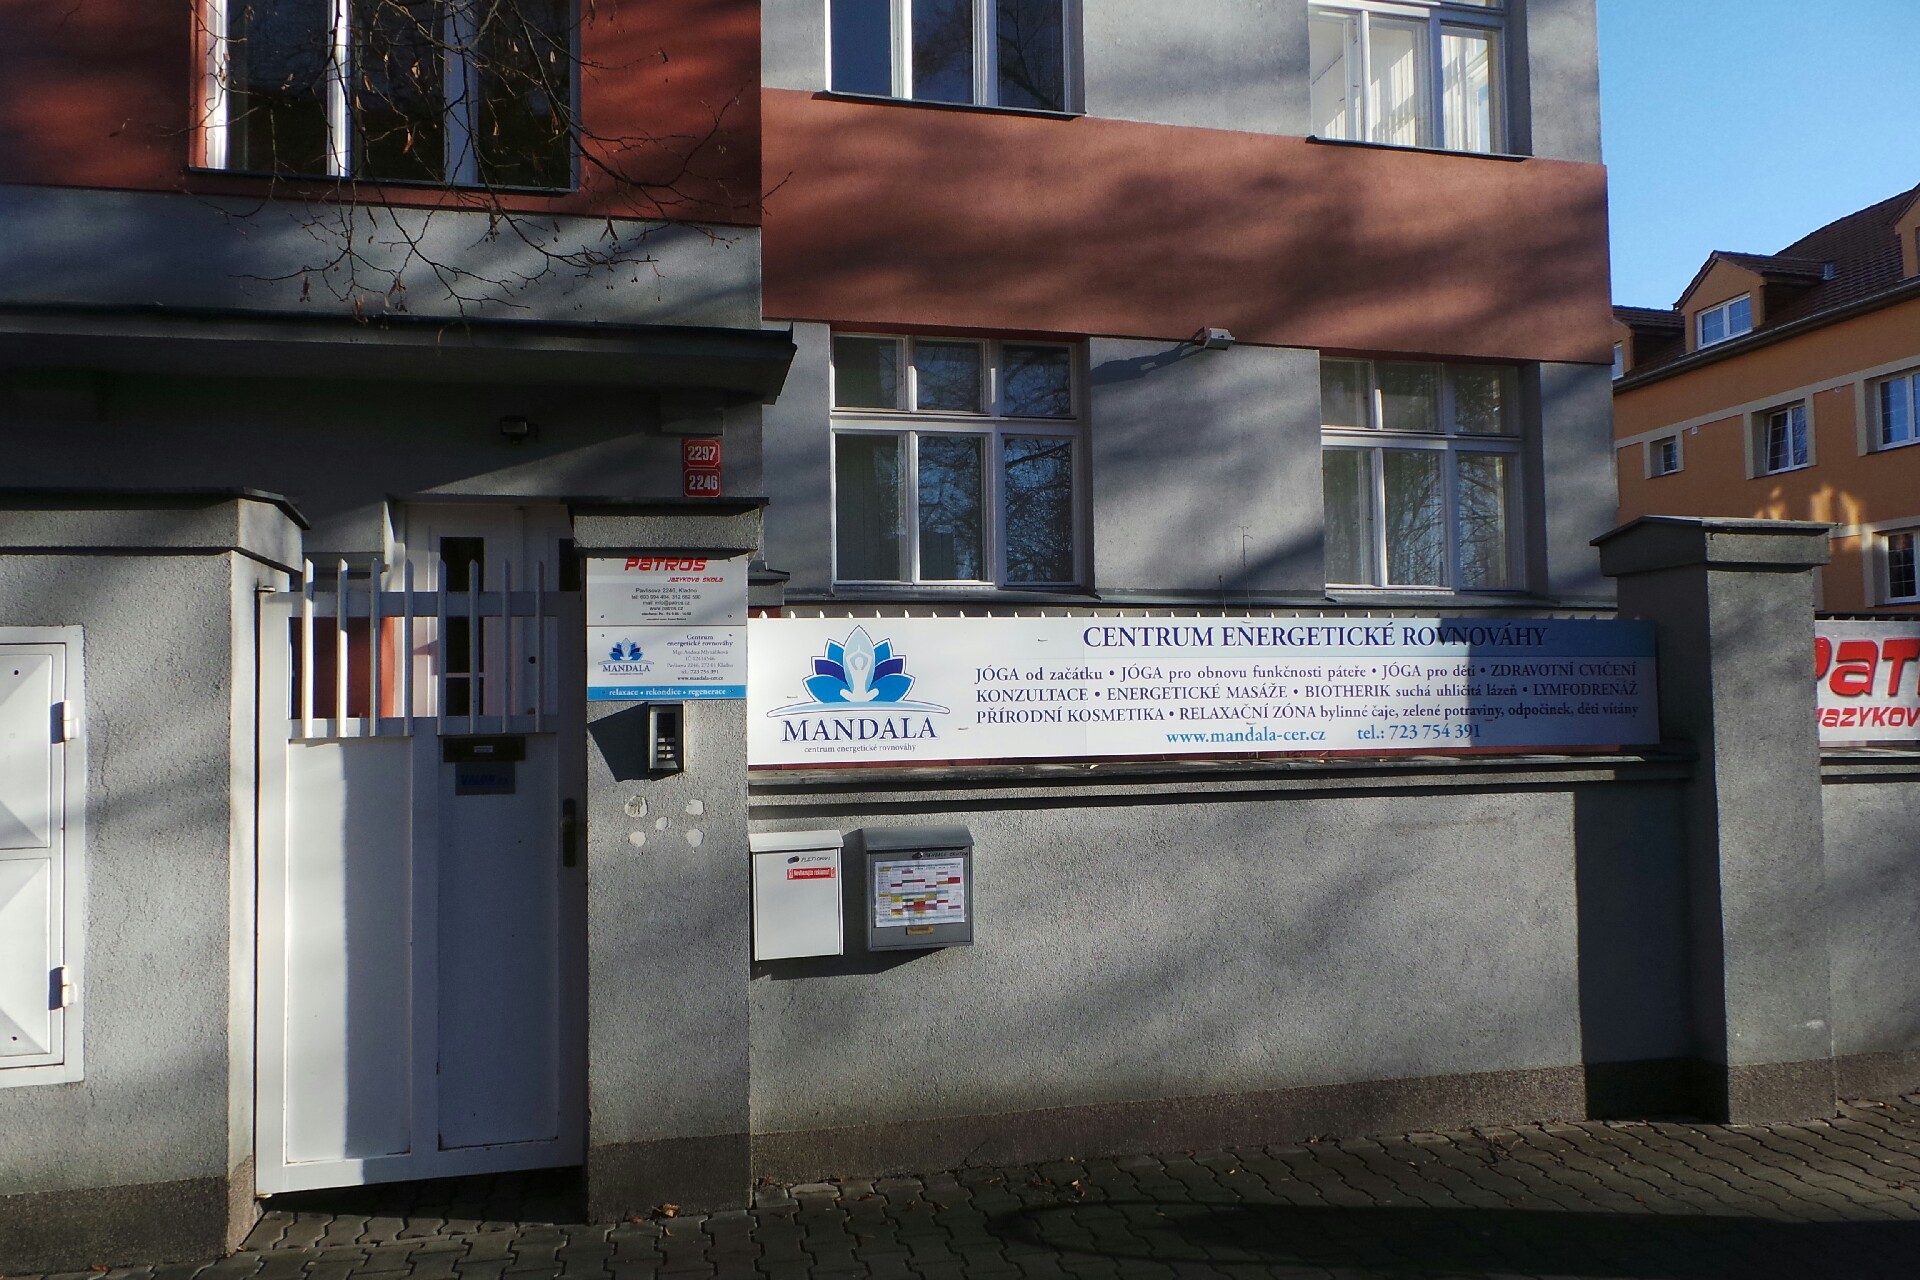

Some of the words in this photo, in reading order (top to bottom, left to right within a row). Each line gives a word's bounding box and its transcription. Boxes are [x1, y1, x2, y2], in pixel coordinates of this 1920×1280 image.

[688, 446, 716, 460] 2297
[689, 475, 717, 490] 2246
[1084, 626, 1214, 647] CENTRUM
[1221, 622, 1393, 647] ENERGETICKÉ
[1402, 623, 1548, 646] ROVNOVÁHY
[975, 664, 1018, 684] JÓGA
[1025, 667, 1043, 681] od
[1049, 665, 1103, 680] začátku
[1120, 663, 1162, 682] JÓGA
[1169, 669, 1191, 682] pro
[1198, 666, 1247, 679] obnovu
[1253, 664, 1321, 678] funkčnosti
[1328, 663, 1366, 680] páteře
[1382, 662, 1421, 680] JÓGA
[1427, 667, 1447, 680] pro
[1453, 663, 1475, 677] děti
[1491, 661, 1574, 676] ZDRAVOTNÍ
[1579, 661, 1637, 676] CVIČENÍ
[609, 688, 638, 696] relaxace
[646, 687, 681, 695] rekondice
[688, 688, 726, 697] regenerace
[976, 688, 1089, 703] KONZULTACE
[1107, 684, 1220, 701] ENERGETICKÉ
[1227, 683, 1287, 698] MASÁŽE
[1305, 685, 1390, 697] BIOTHERIK
[1396, 685, 1430, 697] suchá
[1436, 684, 1481, 696] uhličitá
[1487, 684, 1517, 696] lázeň
[1533, 680, 1638, 696] LYMFODRENÁŽ
[977, 707, 1061, 724] PŘÍRODNÍ
[1068, 708, 1164, 722] KOSMETIKA
[1180, 704, 1269, 720] RELAXAČNÍ
[1273, 703, 1315, 719] ZÓNA
[1321, 705, 1367, 721] bylinné
[1372, 705, 1399, 719] čaje,
[1403, 706, 1440, 717] zelené
[1444, 705, 1504, 720] potraviny,
[1508, 703, 1574, 719] odpočinek,
[1578, 703, 1599, 715] děti
[1603, 703, 1638, 718] vítány
[781, 717, 938, 743] MANDALA
[1166, 727, 1326, 742] www.mandala-cer.cz
[1358, 724, 1385, 740] tel.:
[1390, 725, 1417, 739] 723
[1422, 725, 1451, 739] 754
[1454, 724, 1480, 739] 391
[804, 745, 835, 753] centrum
[836, 744, 877, 753] energetické
[879, 743, 916, 752] rovnováhy
